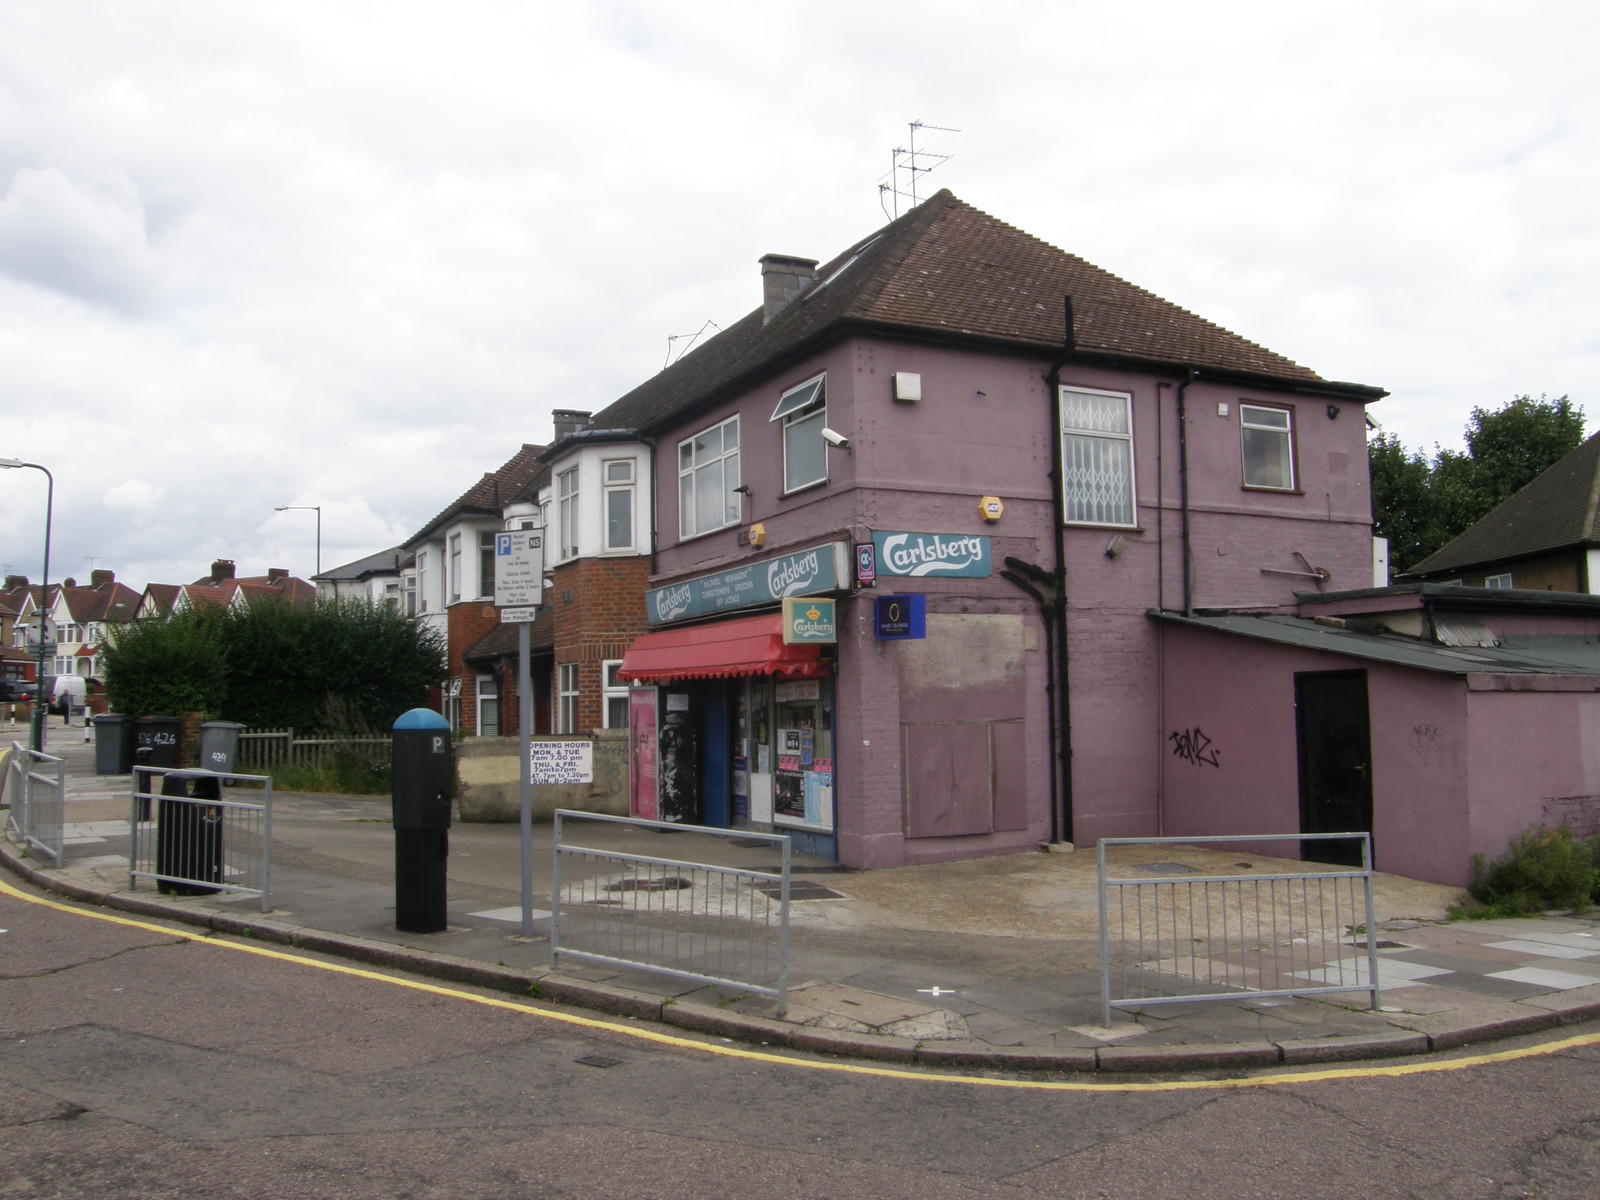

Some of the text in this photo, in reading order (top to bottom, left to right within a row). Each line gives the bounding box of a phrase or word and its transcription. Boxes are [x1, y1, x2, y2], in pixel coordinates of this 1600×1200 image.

[500, 536, 510, 554] P
[883, 534, 982, 574] Carlsberg
[768, 551, 818, 599] Carlsberg
[656, 584, 691, 621] Carlsberg
[793, 619, 832, 634] Carlsberg
[154, 732, 176, 745] 426
[433, 736, 442, 751] P
